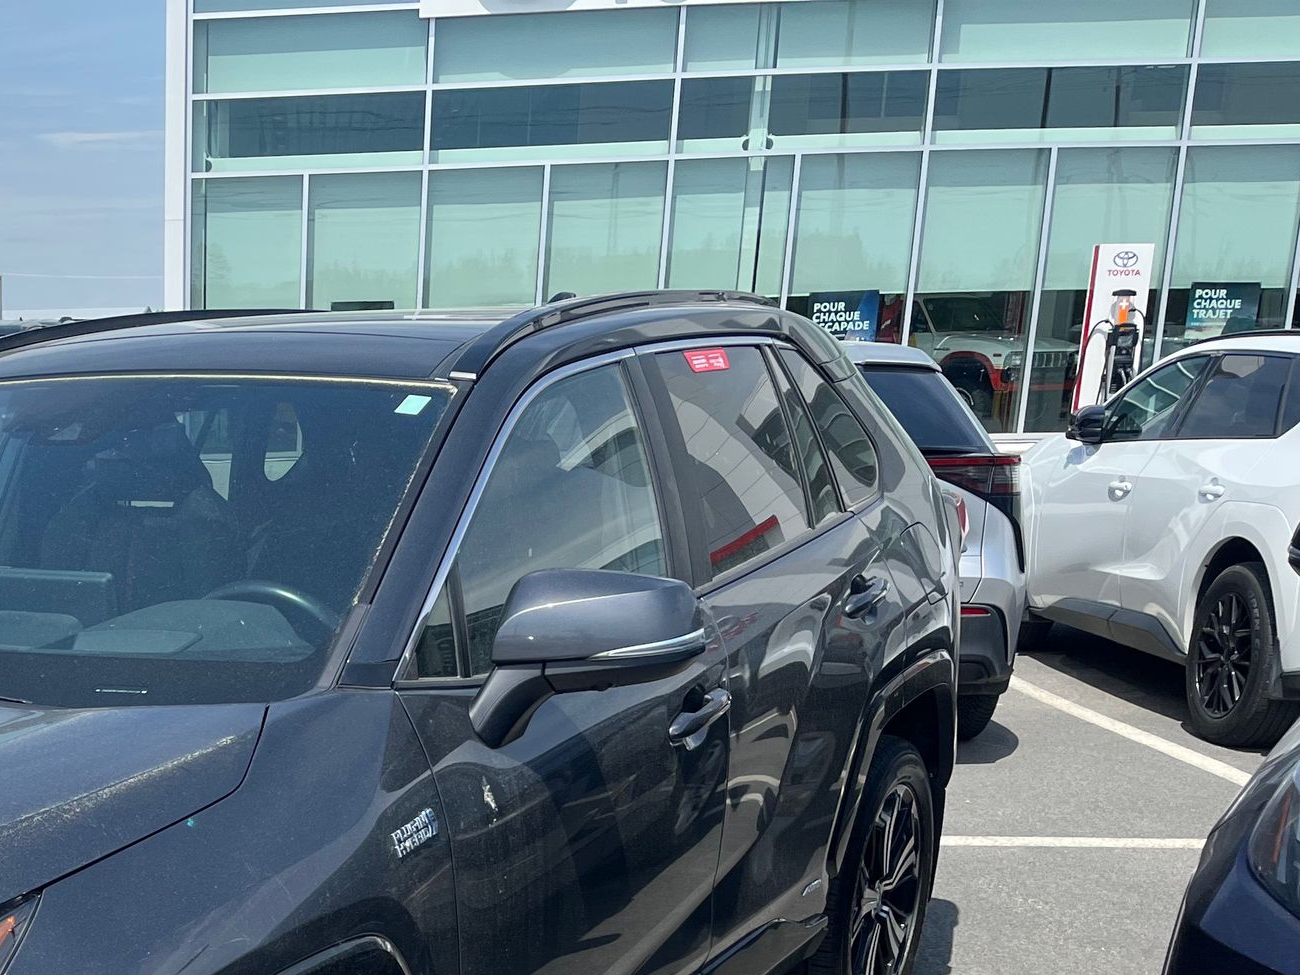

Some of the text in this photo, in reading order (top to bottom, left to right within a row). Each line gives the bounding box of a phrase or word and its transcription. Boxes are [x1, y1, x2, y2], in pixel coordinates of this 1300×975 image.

[1107, 269, 1141, 277] TOYOTA
[1195, 289, 1227, 299] POUR
[813, 302, 845, 312] POUR
[1193, 299, 1242, 309] CHAQUE
[812, 311, 860, 322] CHAQUE
[1192, 309, 1233, 319] TRAJET
